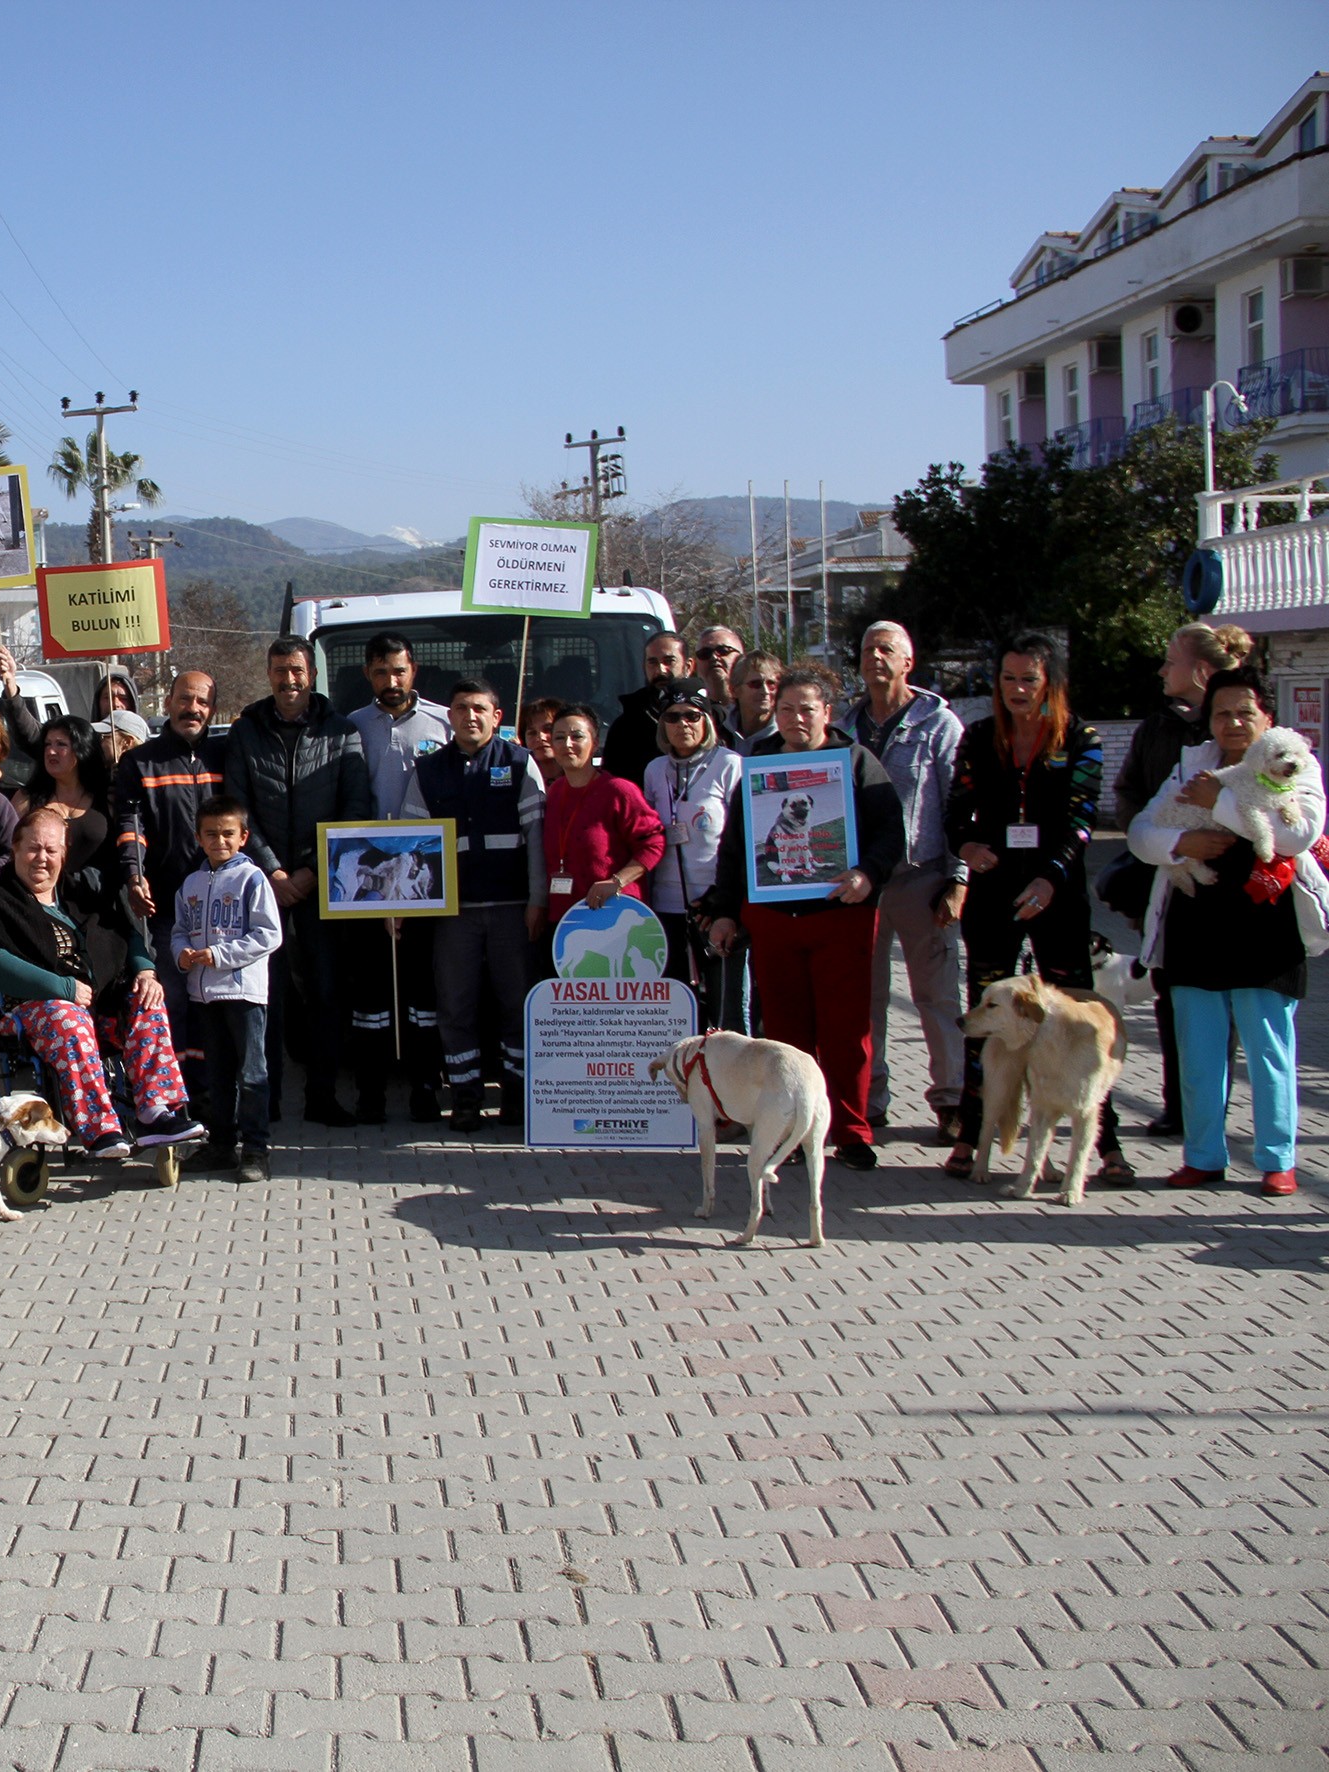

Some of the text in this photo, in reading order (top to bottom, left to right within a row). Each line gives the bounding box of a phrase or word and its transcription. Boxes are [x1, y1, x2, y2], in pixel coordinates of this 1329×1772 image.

[488, 538, 577, 553] SEVMİYOR OLMAN
[496, 556, 566, 572] ÖLDÜRMENİ
[488, 578, 569, 594] GEREKTİRMEZ.
[68, 585, 136, 606] KATİLİMİ
[71, 614, 141, 632] BULUN !!!
[550, 981, 670, 1001] YASAL UYARI
[552, 1007, 582, 1016] Parklar,
[636, 1007, 669, 1016] sokaklar
[534, 1018, 576, 1027] Belediyeye
[577, 1018, 599, 1026] aittir.
[599, 1018, 623, 1026] Sokak
[668, 1018, 687, 1026] 5199
[539, 1029, 560, 1038] sayılı
[606, 1029, 637, 1037] Koruma
[672, 1029, 682, 1037] ile
[542, 1039, 572, 1047] koruma
[573, 1039, 595, 1047] altına
[555, 1049, 584, 1058] vermek
[585, 1049, 605, 1060] yasal
[606, 1049, 630, 1058] olarak
[631, 1051, 658, 1060] cezaya
[586, 1062, 635, 1076] NOTICE
[534, 1079, 555, 1087] Parks,
[556, 1080, 593, 1088] pavements
[608, 1079, 629, 1088] public
[553, 1088, 597, 1097] Municipality.
[598, 1088, 615, 1097] Stray
[535, 1097, 544, 1106] by
[545, 1097, 558, 1105] Law
[559, 1097, 567, 1105] of
[568, 1097, 603, 1106] protection
[605, 1097, 612, 1105] of
[613, 1097, 639, 1105] animals
[552, 1106, 670, 1116] Animal cruelty is punishable by law.
